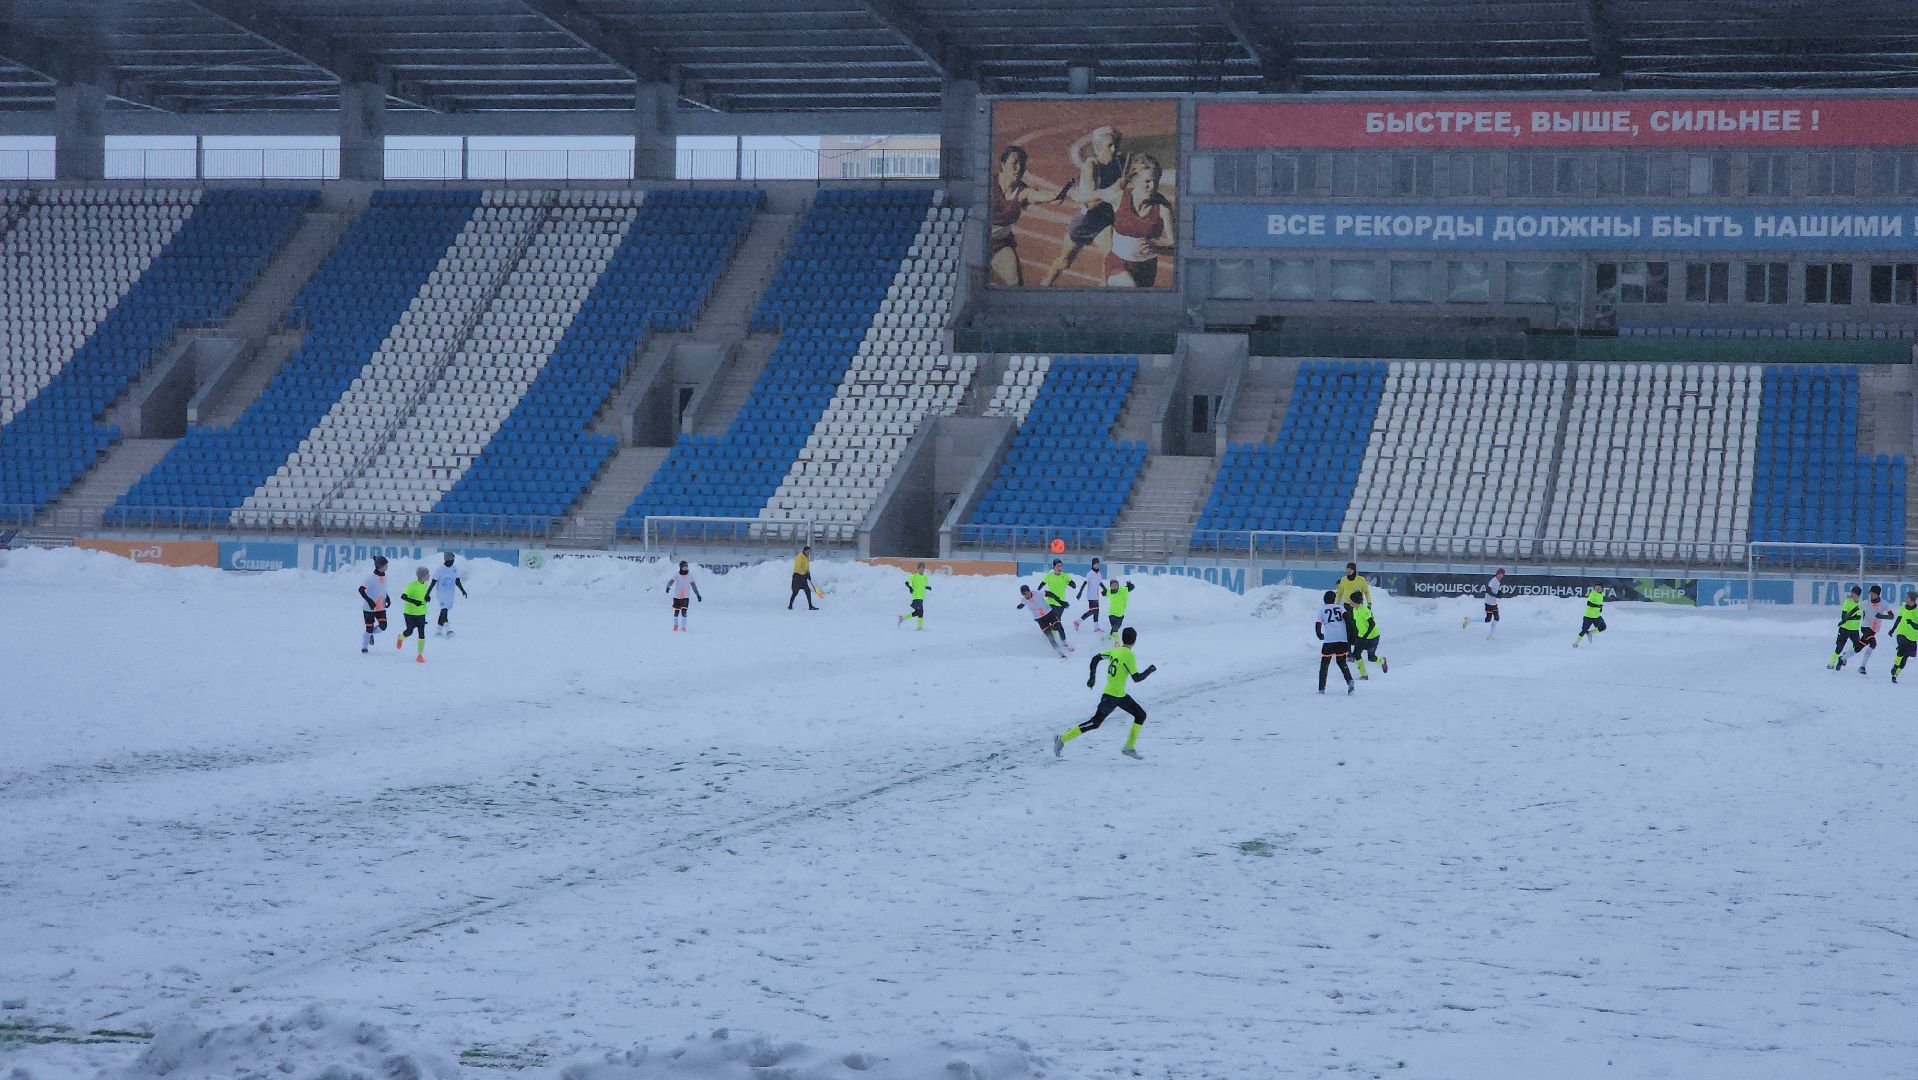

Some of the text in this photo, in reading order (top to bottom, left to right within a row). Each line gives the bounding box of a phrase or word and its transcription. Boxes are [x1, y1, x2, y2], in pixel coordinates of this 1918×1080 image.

[1366, 111, 1520, 136] БЫСТРЕЕ,
[1531, 110, 1639, 136] ВЫШЕ,
[1650, 110, 1801, 131] СИЛЬНЕЕ
[1267, 215, 1325, 235] ВСЕ
[1336, 216, 1483, 240] РЕКОРДЫ
[1493, 216, 1641, 240] ДОЛЖНЫ
[1652, 216, 1743, 237] БЫТЬ
[1754, 216, 1902, 237] НАШИМИ
[1414, 582, 1488, 593] ЮНОШЕСКА
[1585, 586, 1618, 598] ЛГА
[1643, 587, 1686, 599] ЦЕНТР
[1324, 606, 1343, 623] 25
